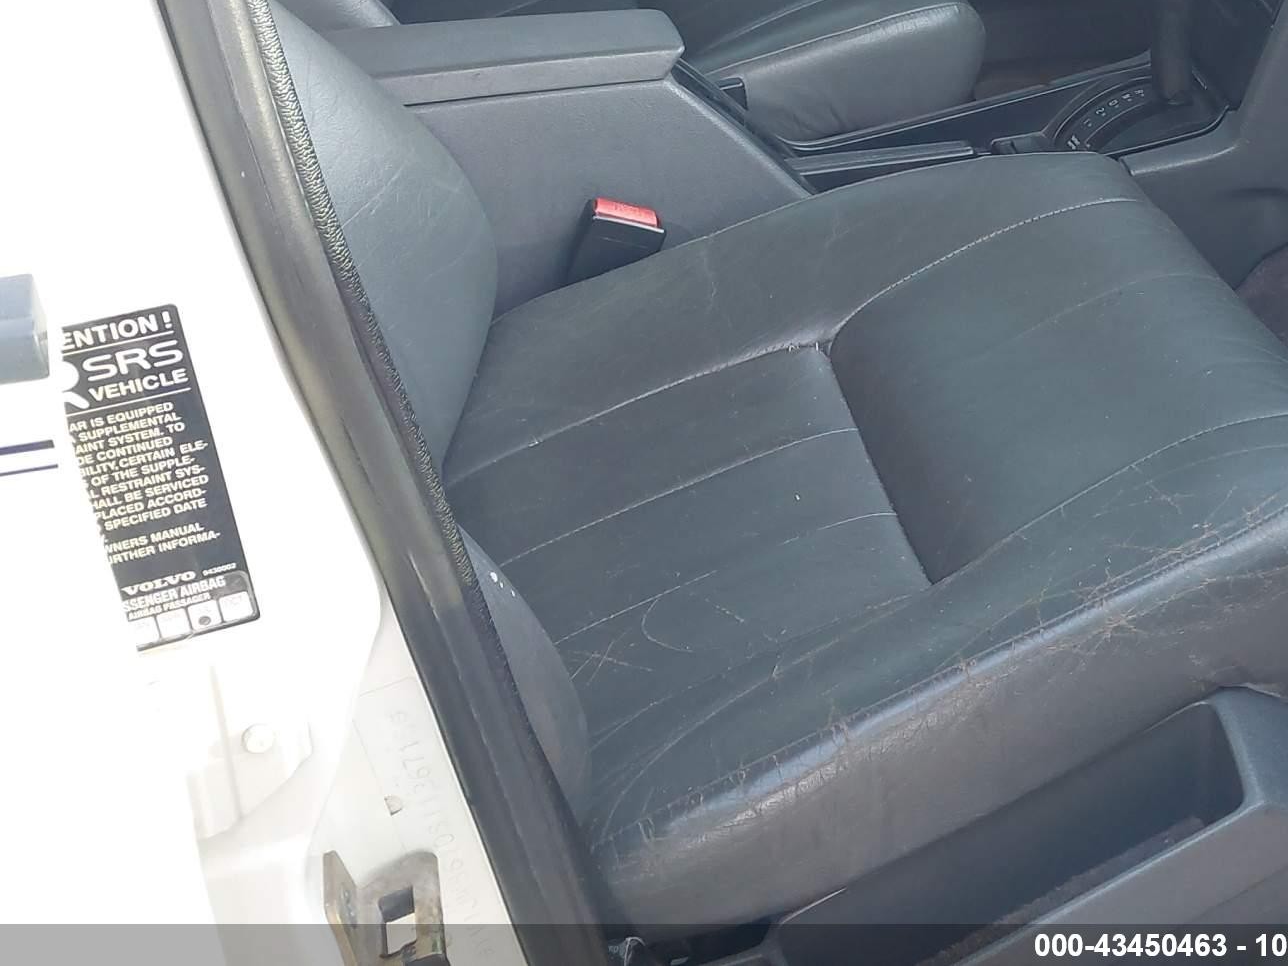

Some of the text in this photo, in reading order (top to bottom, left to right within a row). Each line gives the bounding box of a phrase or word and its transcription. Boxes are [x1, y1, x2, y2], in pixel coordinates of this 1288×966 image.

[82, 339, 184, 382] SRS
[88, 368, 189, 402] VEHICLE
[78, 412, 182, 442] SUPPLEMENTAL
[90, 417, 105, 428] IS
[106, 402, 174, 424] EQUIPPED
[165, 422, 186, 434] TO
[96, 436, 173, 461] CONTINUED
[180, 440, 209, 454] ELE-
[90, 475, 110, 487] OF
[110, 467, 139, 482] THE
[141, 455, 196, 475] SUPPLE-
[100, 471, 173, 496] RESTRAINT
[174, 464, 206, 479] SYS-
[124, 490, 144, 502] BE
[144, 474, 209, 498] SERVICED
[147, 487, 208, 509] ACCORD-
[104, 497, 208, 531] SPECIFIED DATE
[150, 522, 205, 544] MANUAL
[158, 530, 222, 554] INFORMA-
[121, 571, 197, 595] VOLVO
[180, 575, 226, 598] AIRBAG
